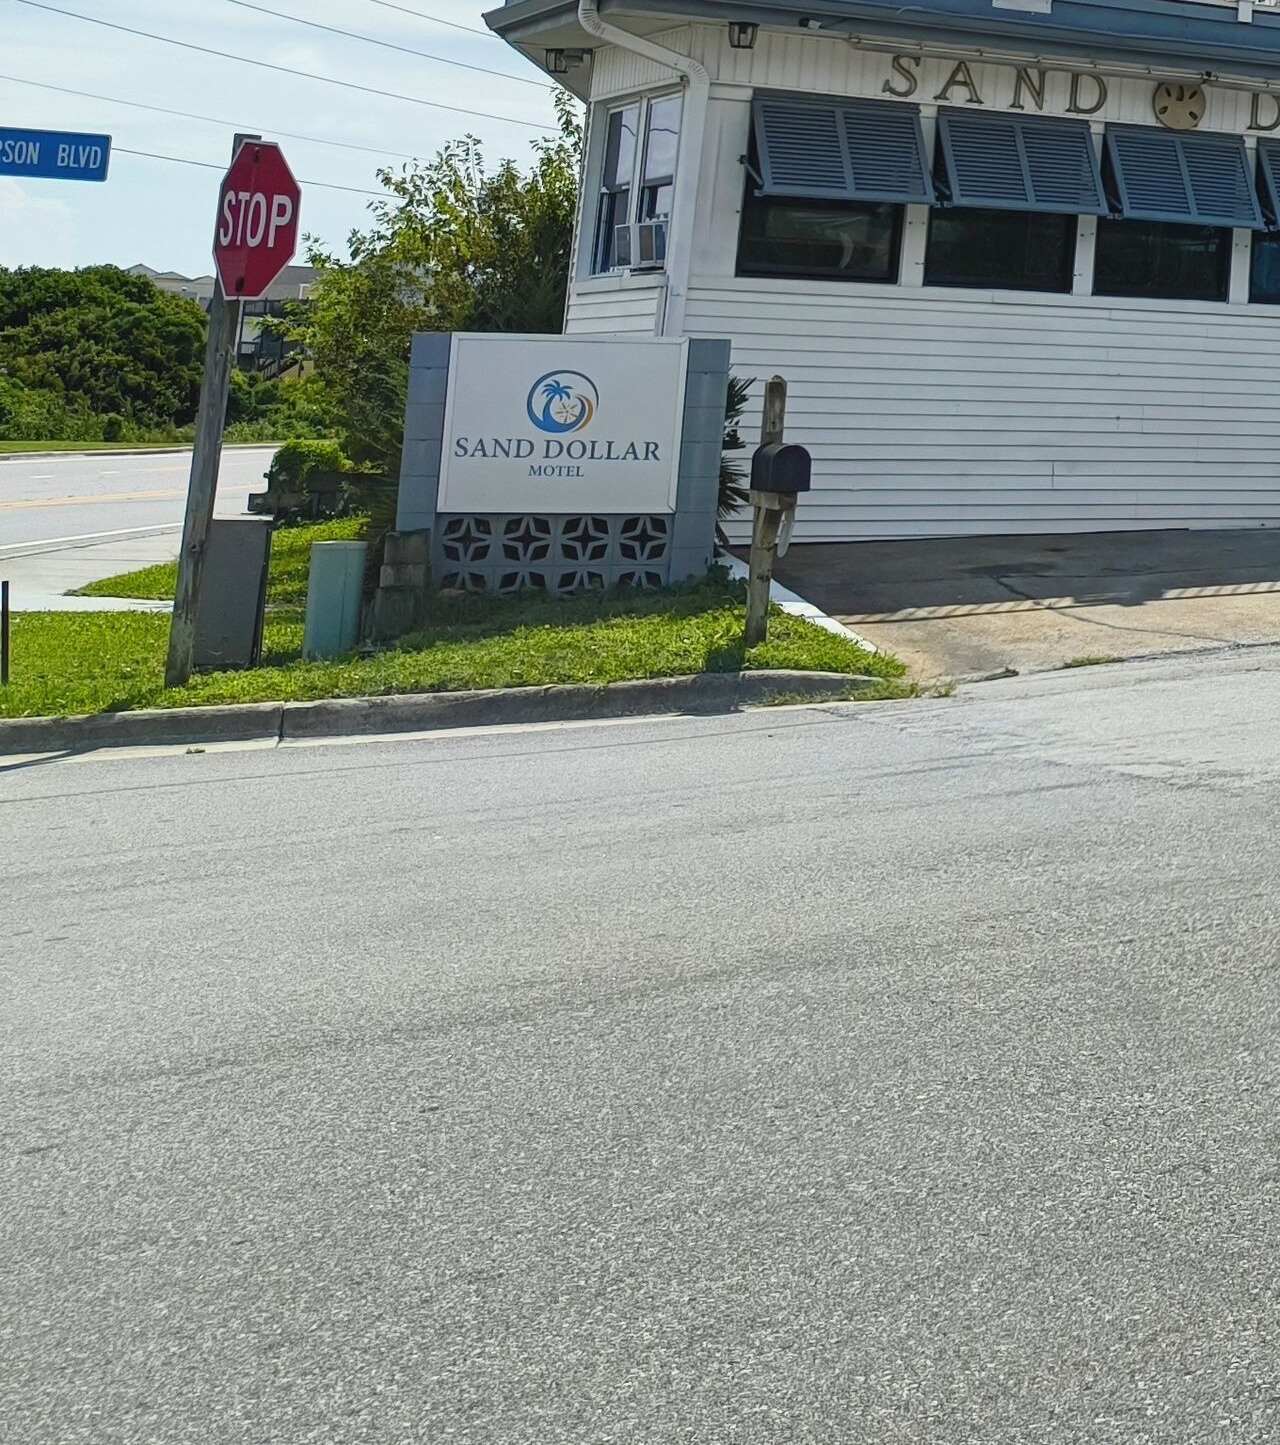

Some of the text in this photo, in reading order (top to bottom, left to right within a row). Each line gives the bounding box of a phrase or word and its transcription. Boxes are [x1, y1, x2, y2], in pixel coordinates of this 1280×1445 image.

[881, 54, 1108, 115] SAND
[56, 144, 102, 169] BLVD
[219, 190, 293, 248] STOP
[454, 437, 661, 461] SAND DOLLAR
[527, 464, 585, 478] MOTEL
